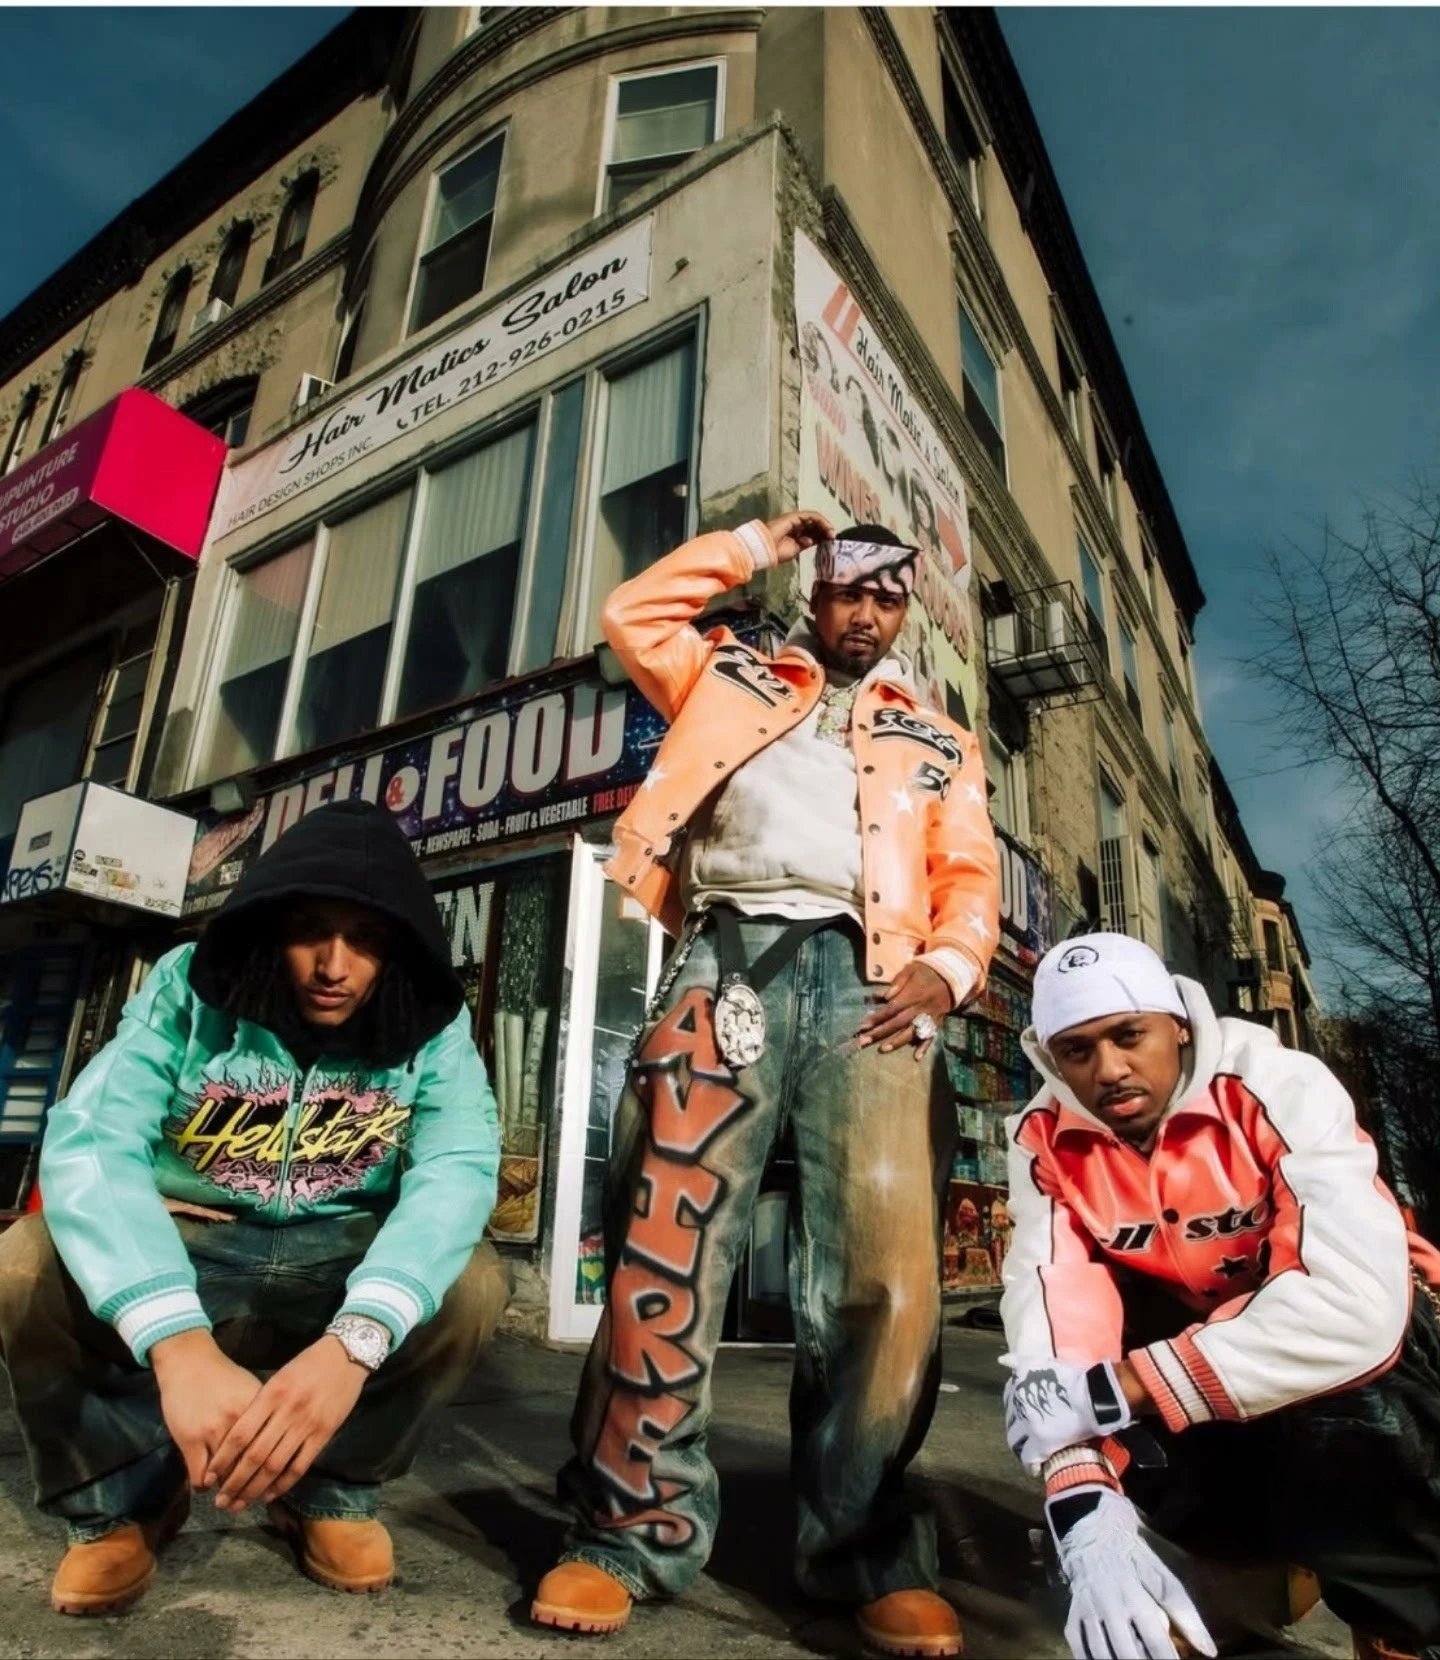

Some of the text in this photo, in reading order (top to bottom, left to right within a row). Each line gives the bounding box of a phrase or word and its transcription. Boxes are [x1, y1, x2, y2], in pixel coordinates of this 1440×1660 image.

[280, 256, 629, 473] Hair Matics Salon
[459, 289, 626, 398] 212-926-0215
[855, 326, 884, 393] Hair
[228, 505, 257, 528] HAIR
[257, 477, 301, 518] DESIGN
[303, 454, 346, 489] SHOPS
[421, 686, 627, 821] FOOD
[505, 810, 531, 835] FRUIT
[540, 796, 588, 826] VEGETABLE
